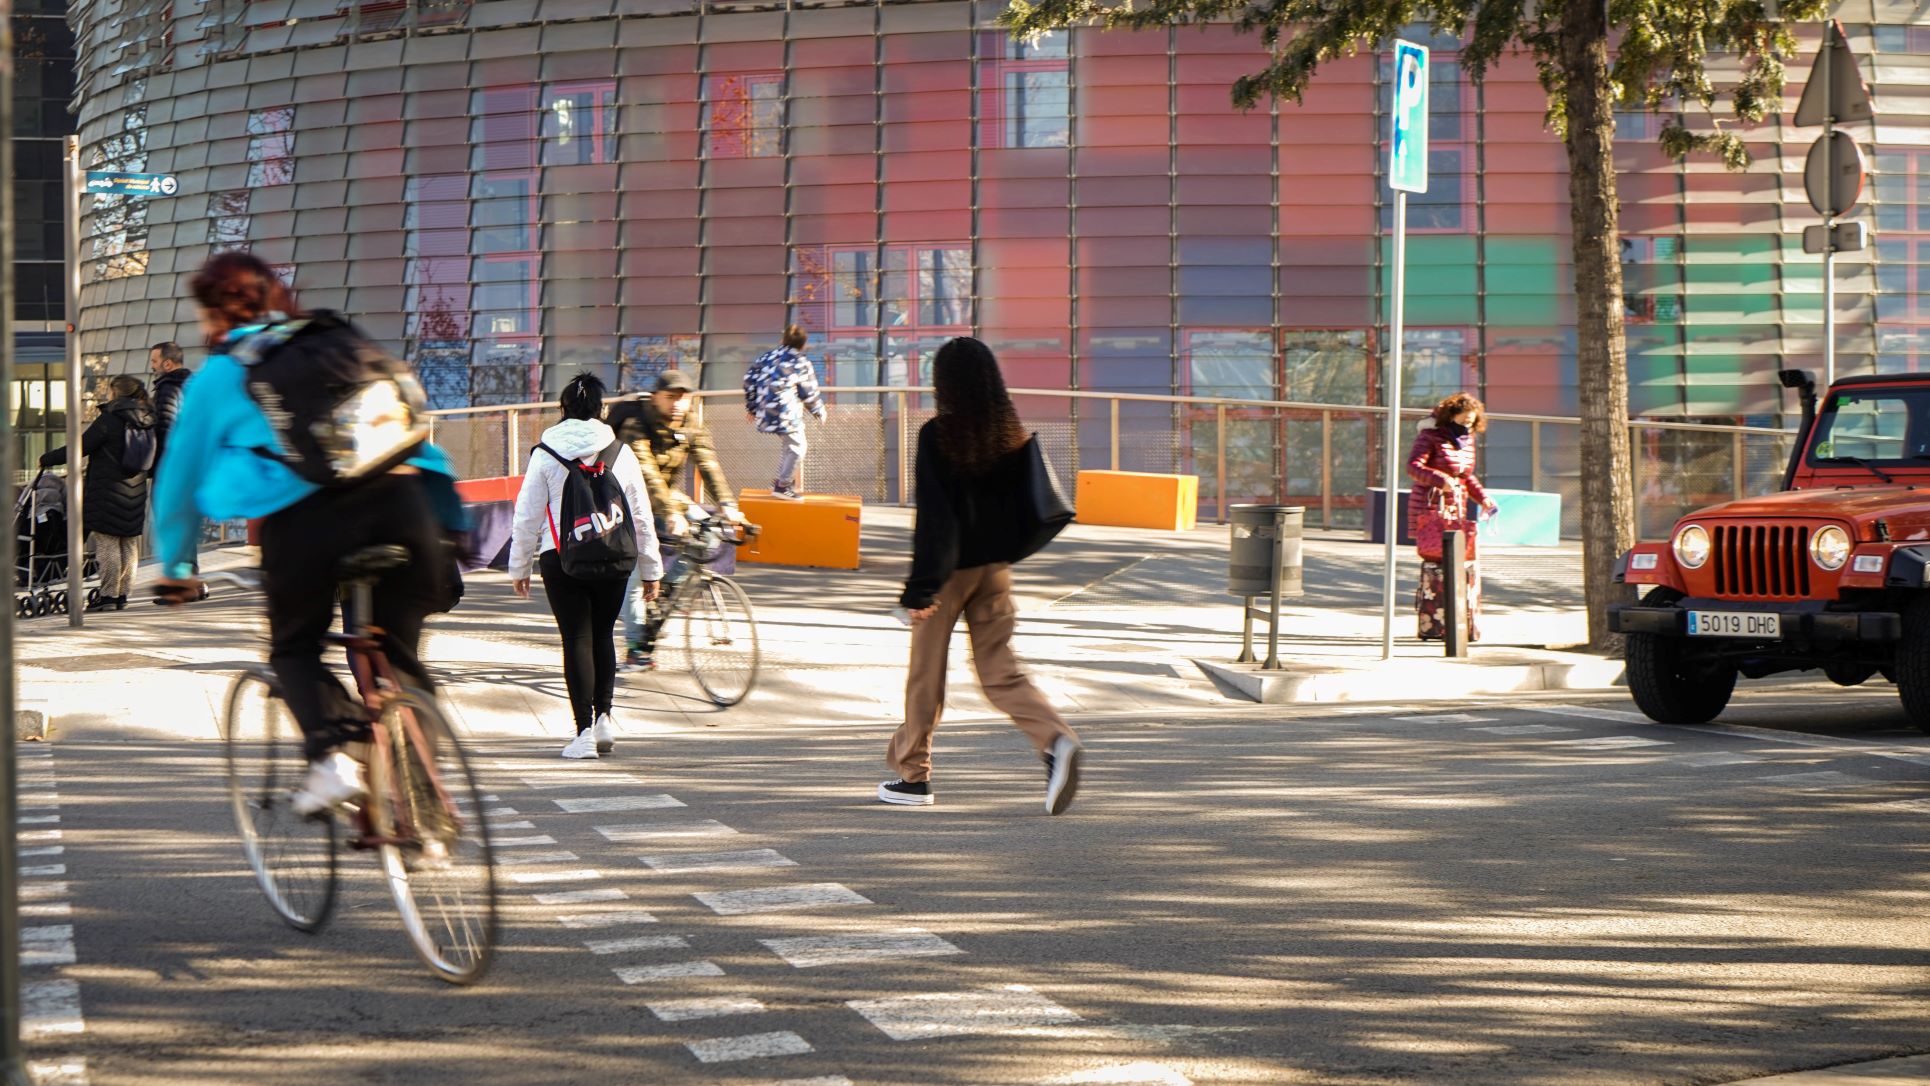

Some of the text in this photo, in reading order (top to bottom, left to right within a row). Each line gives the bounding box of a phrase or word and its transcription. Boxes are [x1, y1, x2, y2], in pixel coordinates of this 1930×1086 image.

[1399, 54, 1423, 130] P
[573, 503, 624, 541] FILA
[1701, 615, 1776, 634] 5019 DHC
